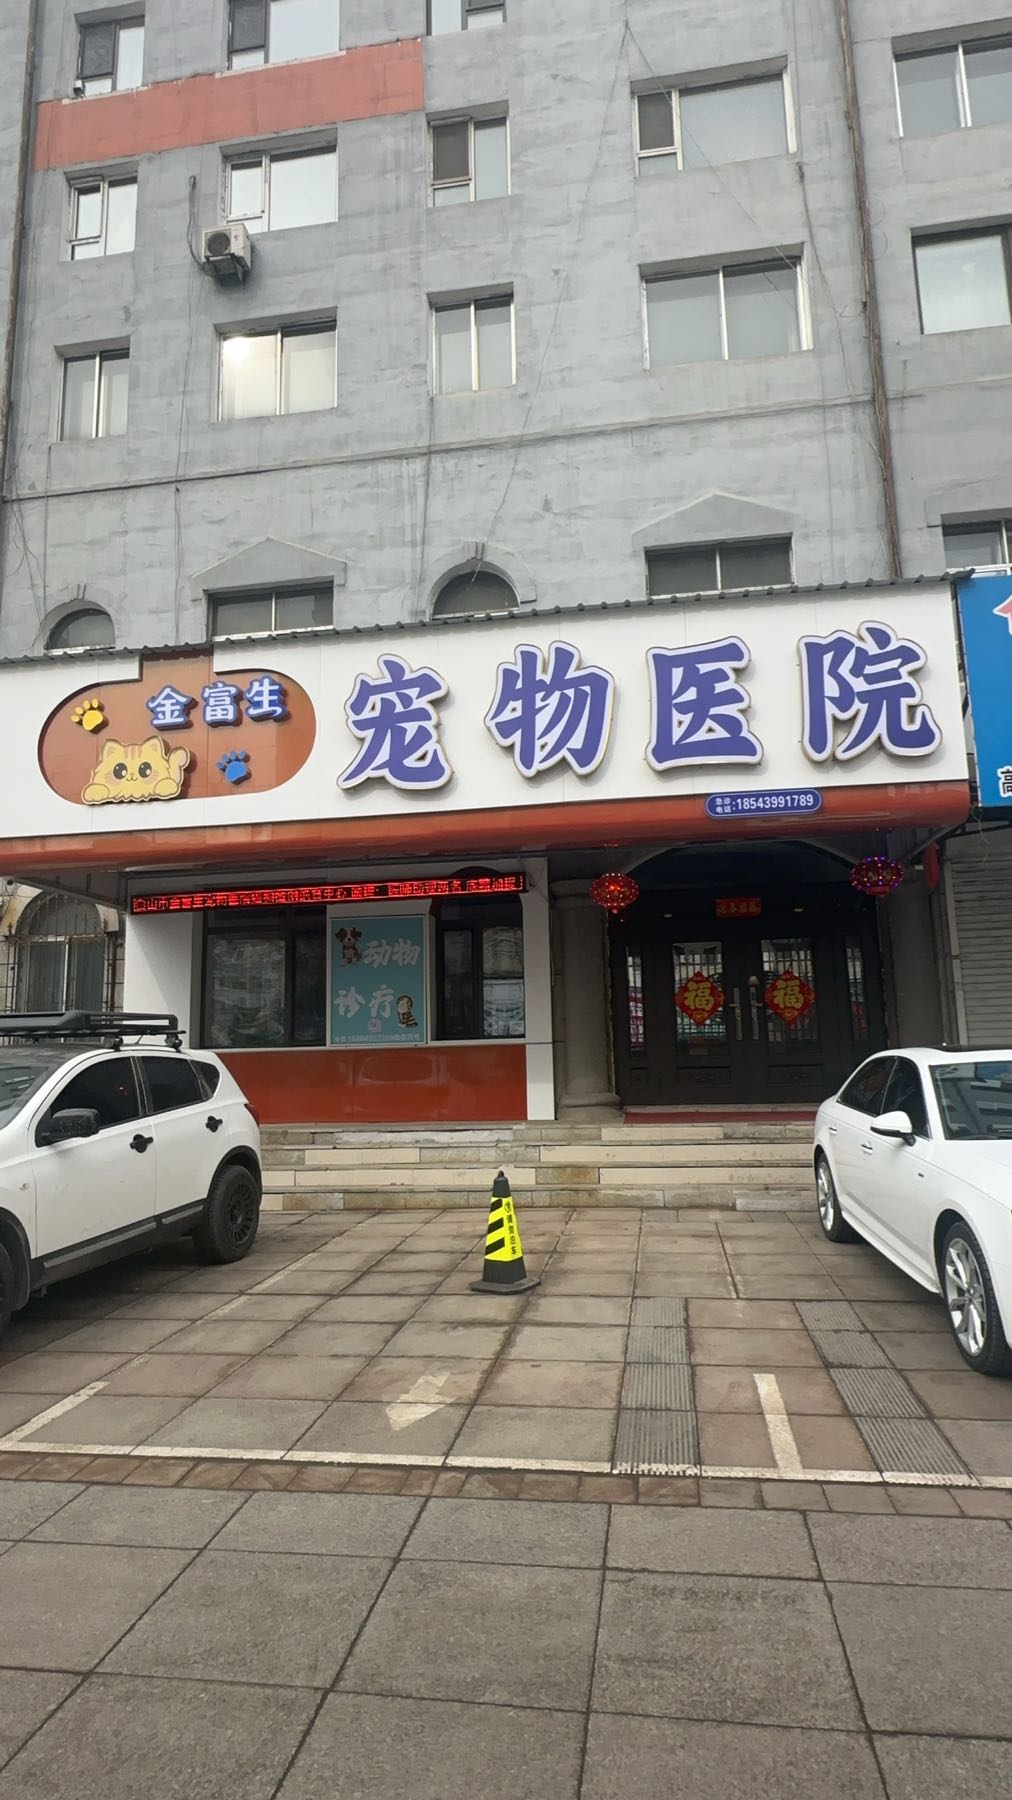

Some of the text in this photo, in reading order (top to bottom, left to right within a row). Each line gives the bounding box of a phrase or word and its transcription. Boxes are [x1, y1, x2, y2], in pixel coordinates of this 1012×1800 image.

[146, 675, 289, 730] 金富生
[339, 621, 942, 792] 宠物医院
[363, 938, 421, 968] 动物
[334, 984, 395, 1018] 诊疗
[684, 981, 714, 1011] 福
[773, 979, 804, 1009] 福
